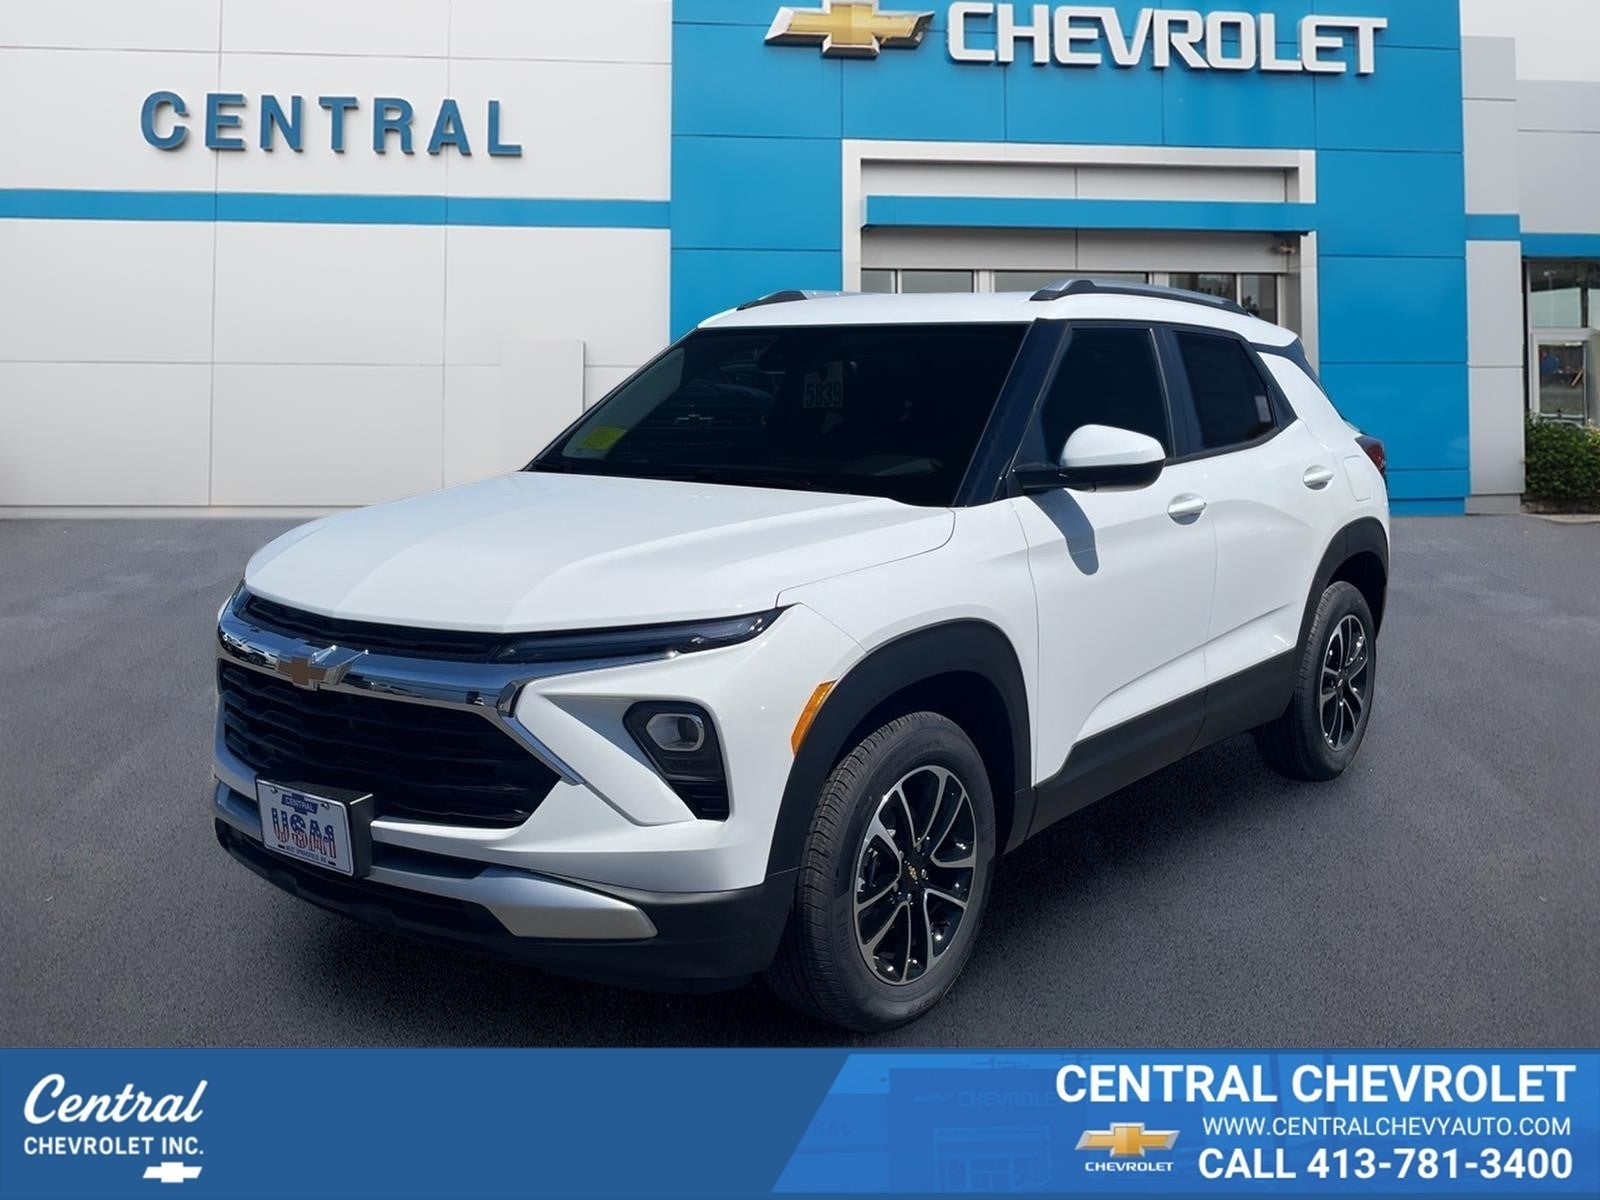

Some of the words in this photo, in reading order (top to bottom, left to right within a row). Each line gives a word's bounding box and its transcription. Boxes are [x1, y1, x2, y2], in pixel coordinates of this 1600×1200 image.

[947, 1, 1388, 76] CHEVROLET
[140, 90, 524, 157] CENTRAL
[804, 382, 843, 407] 5839
[285, 797, 315, 811] CENTRAL
